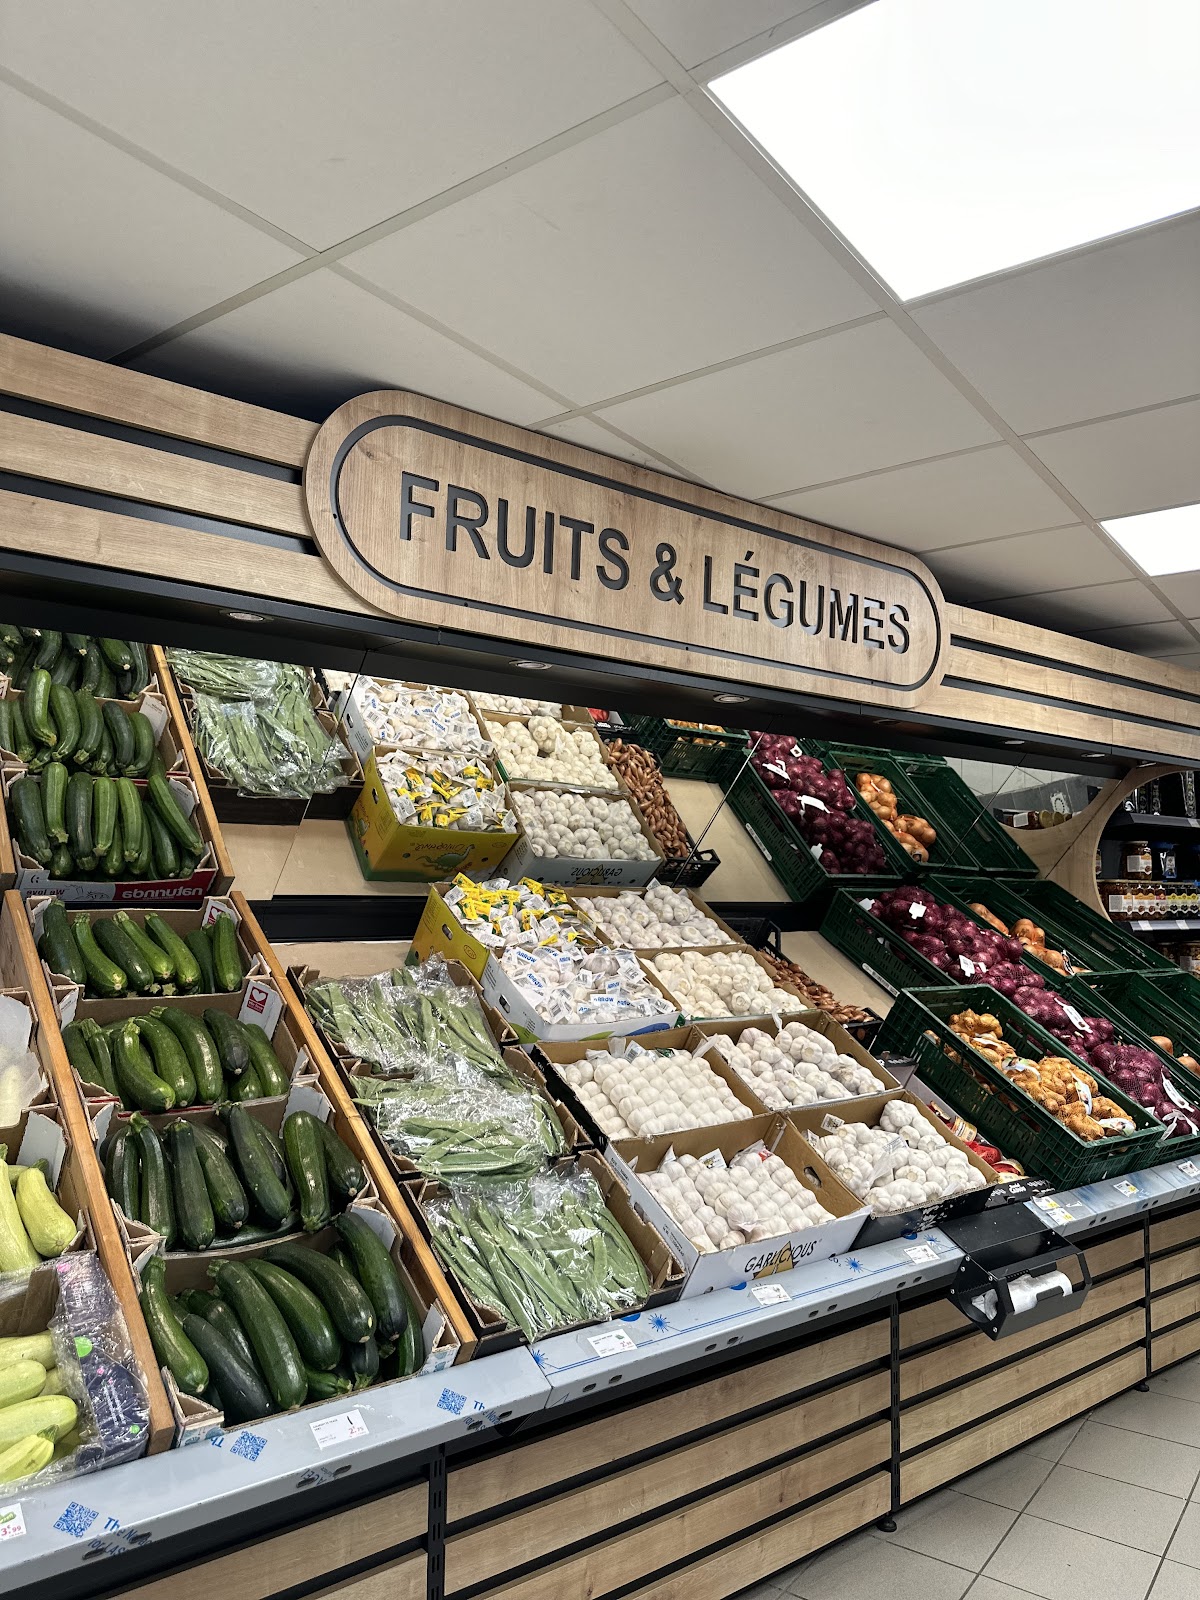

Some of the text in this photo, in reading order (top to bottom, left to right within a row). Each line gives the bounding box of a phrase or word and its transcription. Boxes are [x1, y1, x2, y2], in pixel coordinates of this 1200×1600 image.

[400, 471, 910, 655] FRUITS & LÉGUMES
[744, 1240, 818, 1273] GARLICIOUS
